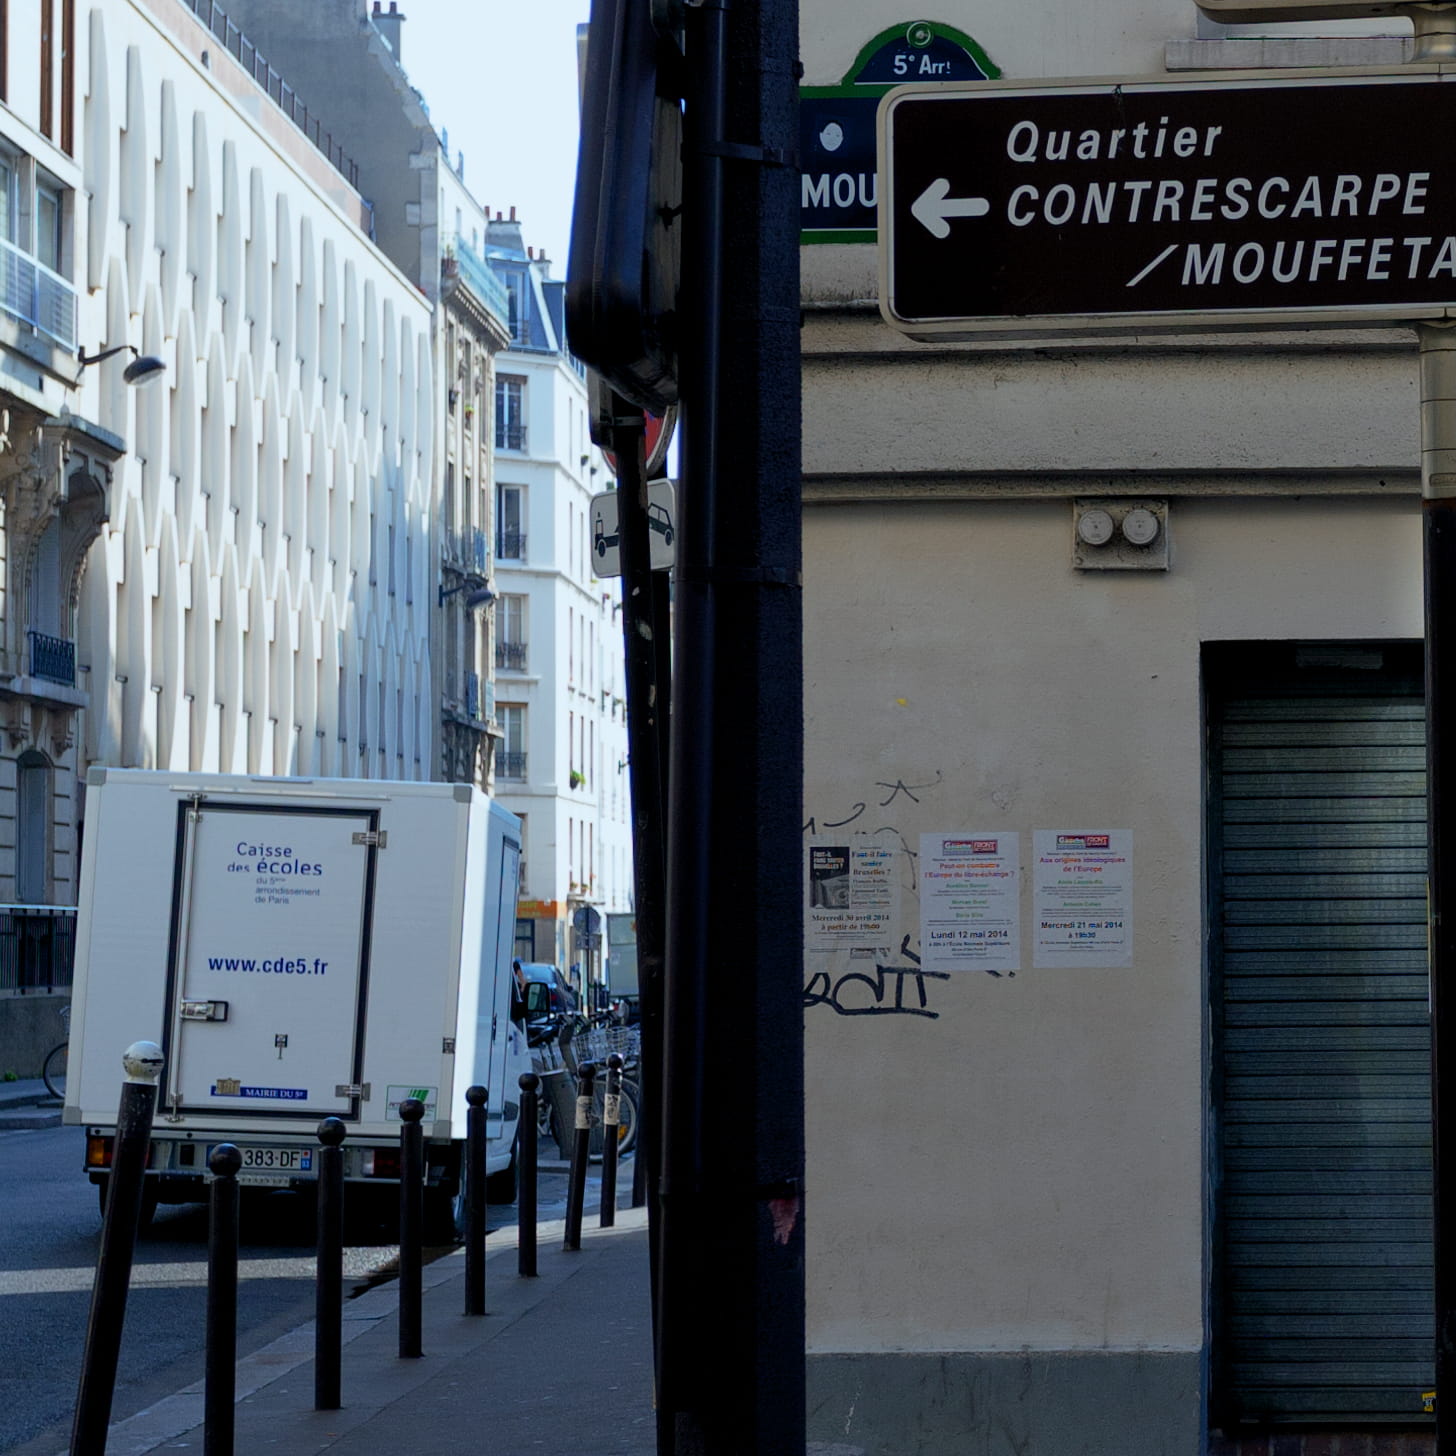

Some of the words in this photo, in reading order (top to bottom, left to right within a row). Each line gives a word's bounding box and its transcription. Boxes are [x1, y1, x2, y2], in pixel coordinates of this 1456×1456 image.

[1006, 116, 1223, 163] Quartier
[1007, 172, 1430, 227] CONTRESCARPE
[237, 841, 292, 858] Caisse
[227, 862, 250, 873] des
[256, 857, 323, 876] écoles
[255, 877, 267, 885] du
[255, 887, 320, 896] arrondissement
[255, 896, 266, 904] de
[268, 896, 290, 905] Paris
[1041, 921, 1075, 929] Mercredi
[931, 931, 956, 939] Lundi
[959, 931, 968, 939] 12
[970, 931, 986, 939] mai
[987, 930, 1008, 939] 2014
[208, 957, 329, 975] www.cde5.fr
[245, 1089, 279, 1097] MAIRIE
